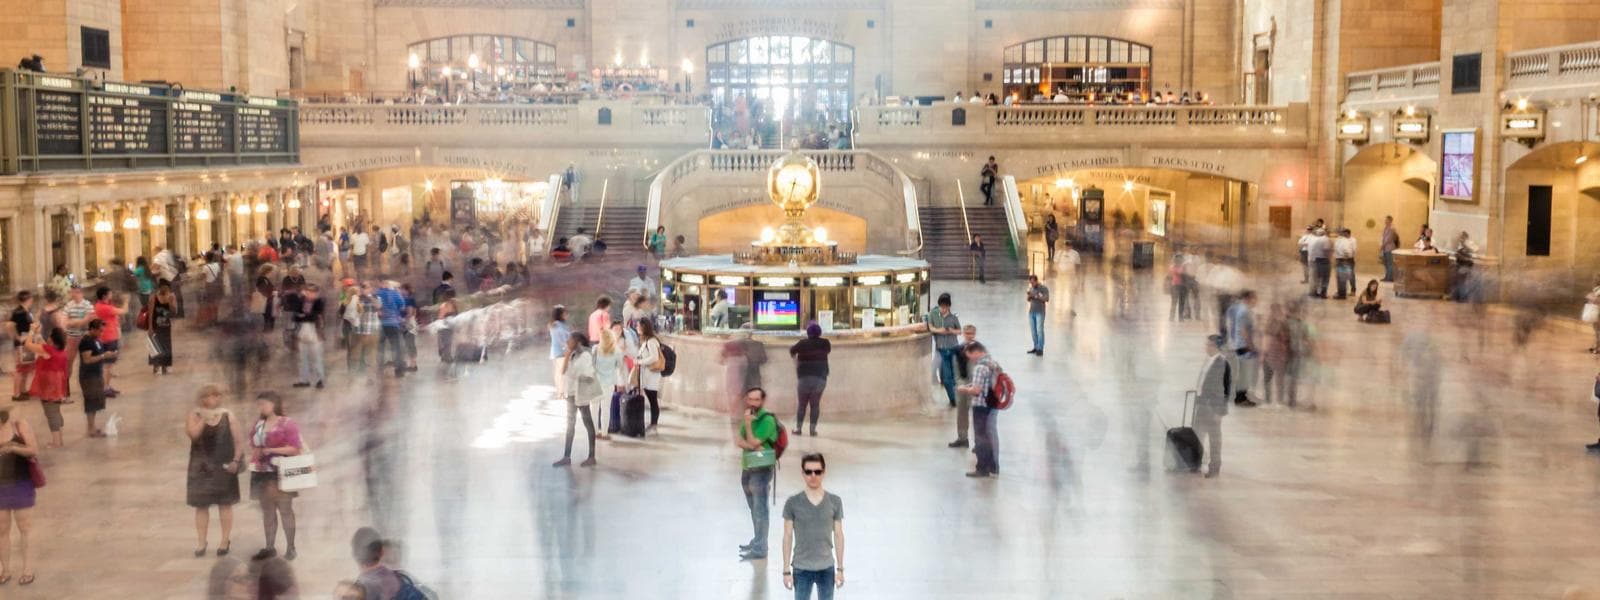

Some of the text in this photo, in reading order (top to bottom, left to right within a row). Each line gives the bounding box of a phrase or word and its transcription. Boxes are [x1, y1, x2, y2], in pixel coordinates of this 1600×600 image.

[320, 155, 411, 174] TICKET MACHINES
[1035, 155, 1119, 175] TICKET MACHINES
[1152, 156, 1188, 167] TRACKS
[1201, 160, 1214, 171] TO
